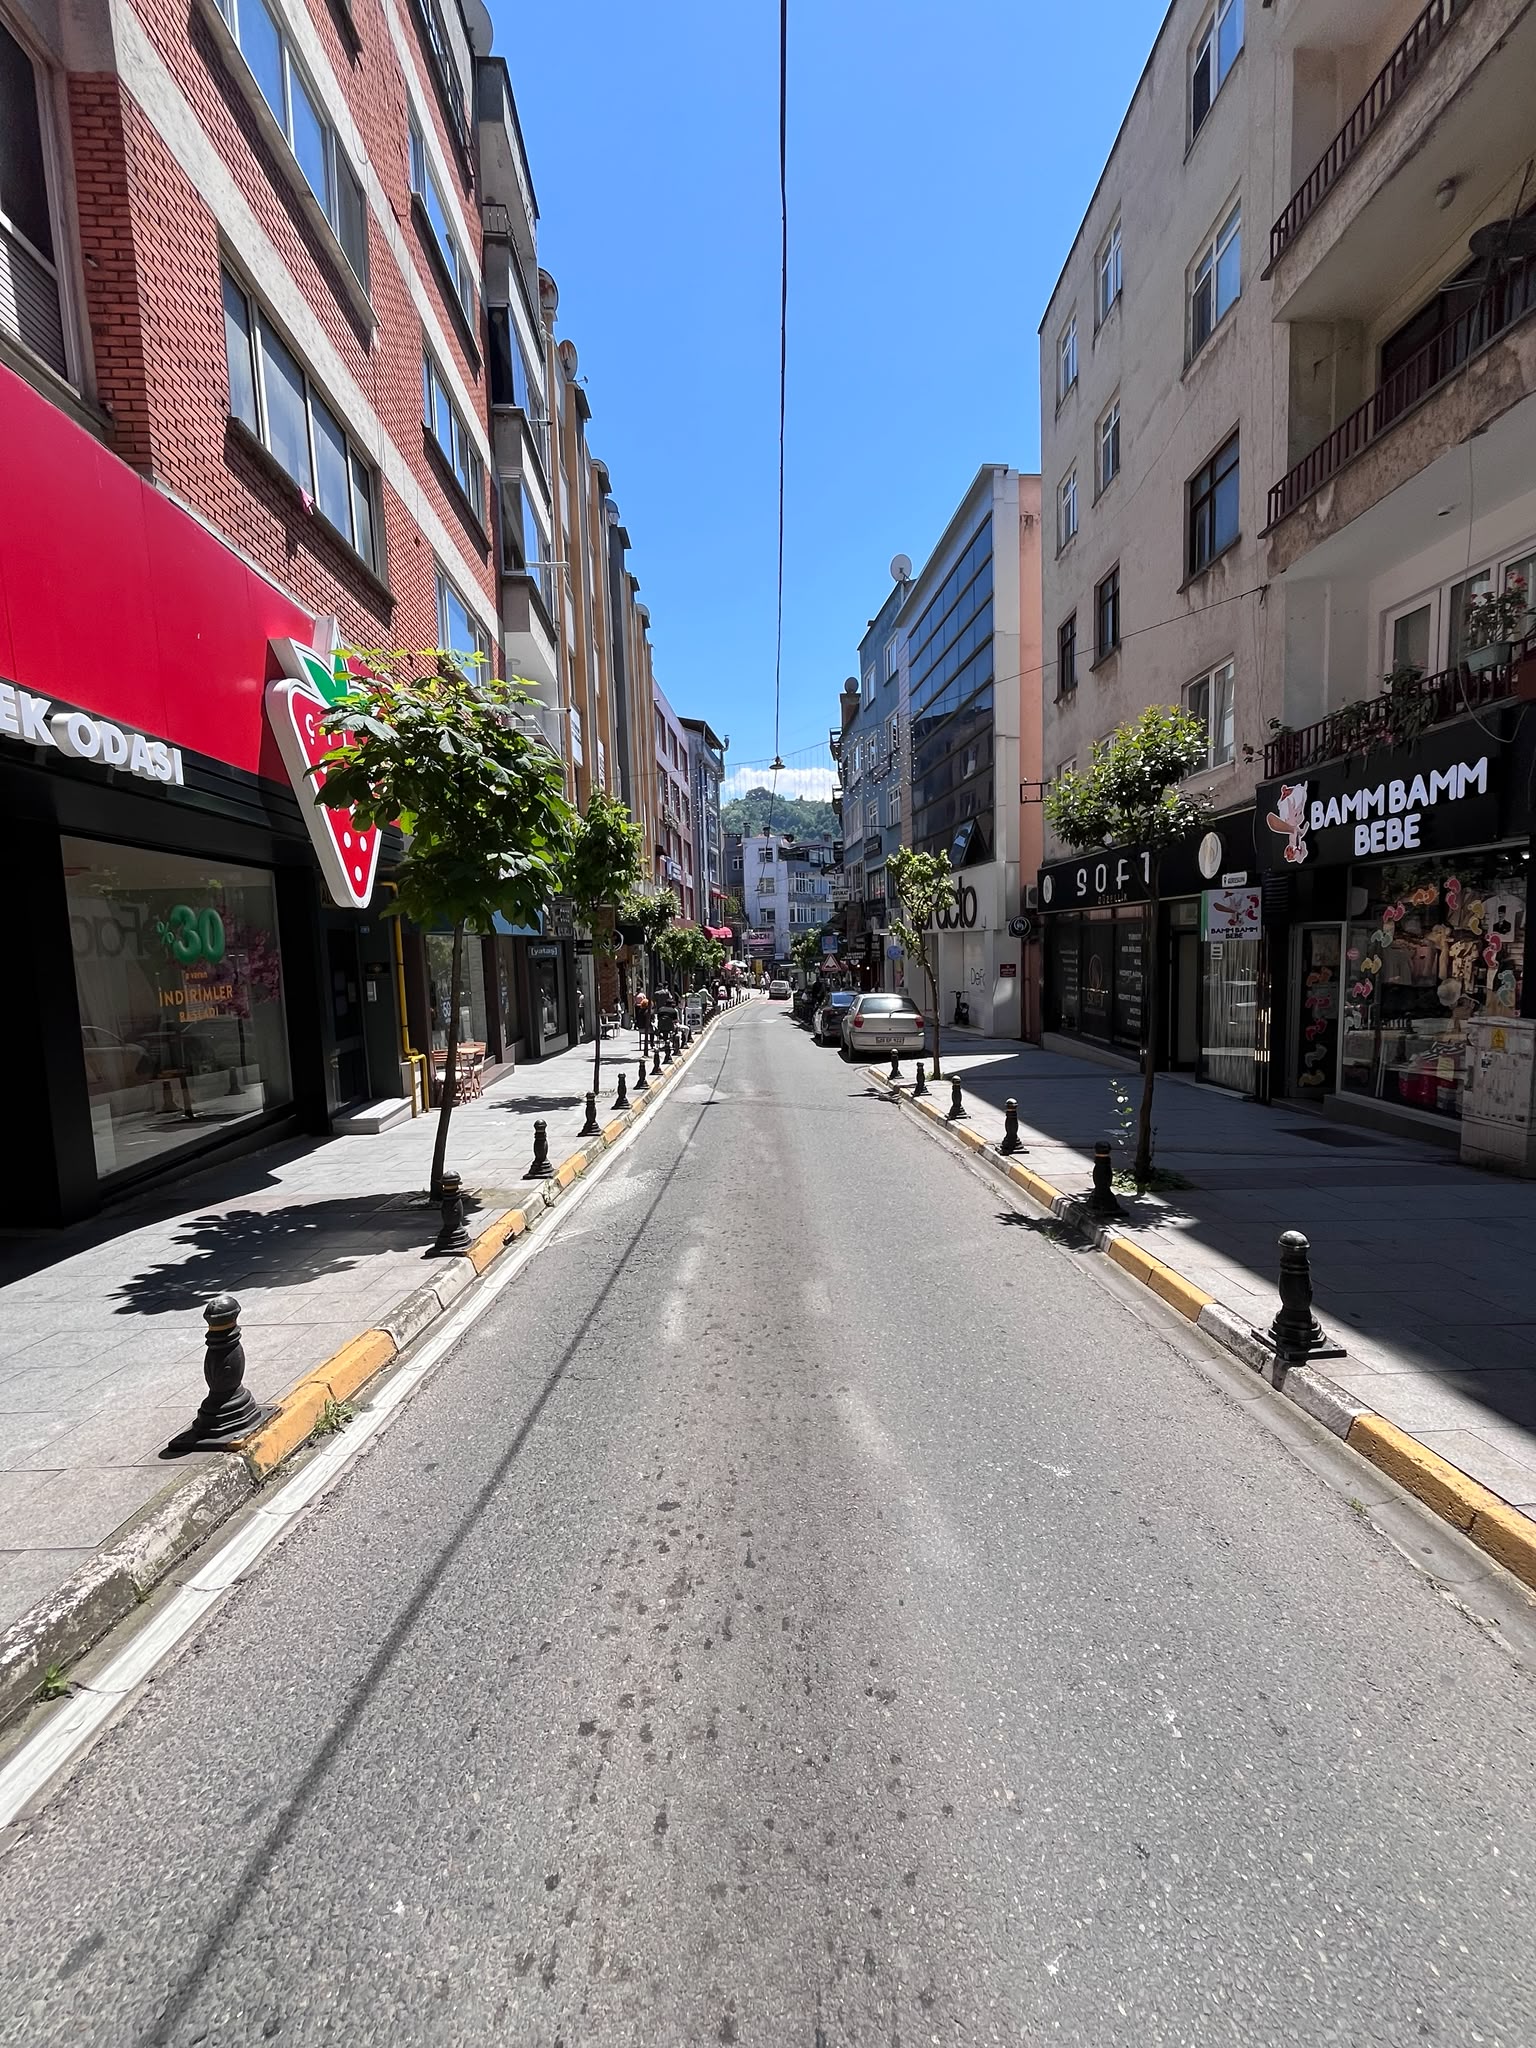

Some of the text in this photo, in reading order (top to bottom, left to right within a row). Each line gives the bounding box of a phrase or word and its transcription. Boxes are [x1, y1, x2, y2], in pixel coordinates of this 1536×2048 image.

[65, 712, 185, 786] ODASI
[1310, 756, 1488, 831] BAMM BAMM
[1354, 813, 1422, 856] BEBE
[158, 985, 233, 1008] İNDİRİMLER
